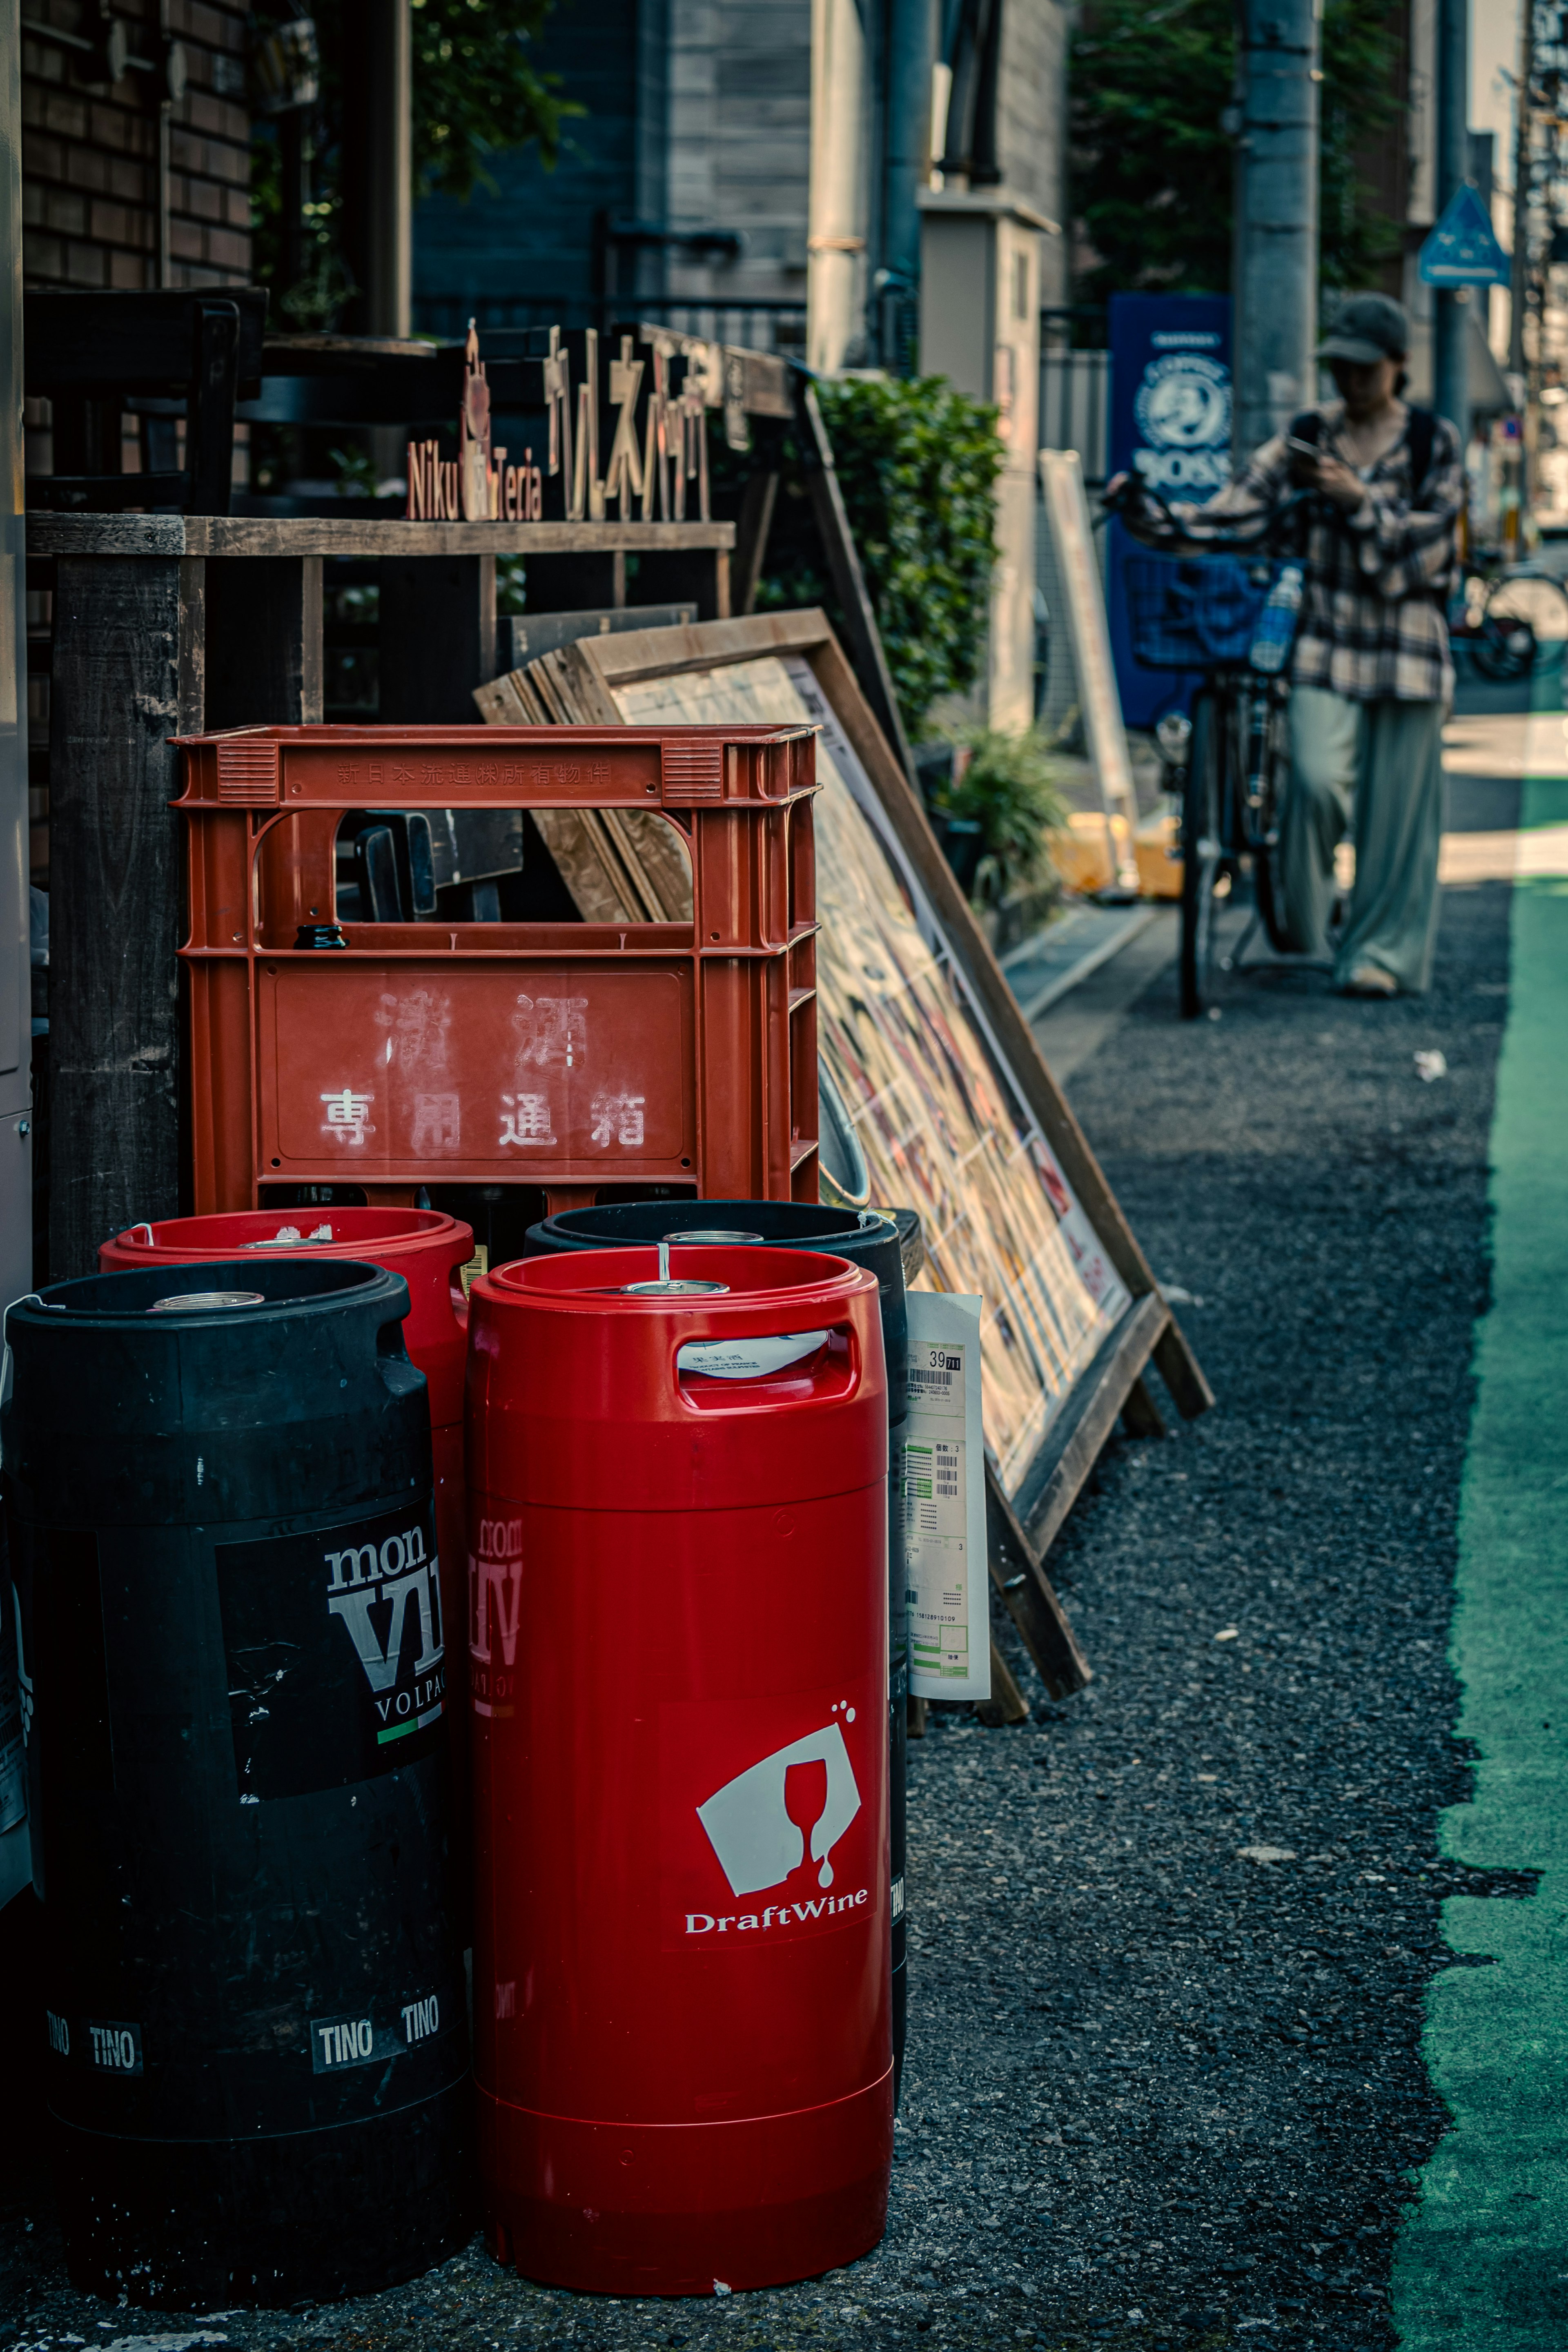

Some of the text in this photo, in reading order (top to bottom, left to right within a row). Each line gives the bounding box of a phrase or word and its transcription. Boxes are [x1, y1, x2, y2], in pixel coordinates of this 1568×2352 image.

[693, 1354, 743, 1363] 果実酒
[930, 1351, 945, 1368] 39
[947, 1359, 959, 1369] 711
[325, 1526, 426, 1591] mon
[917, 1613, 956, 1621] 158128910109
[685, 1889, 868, 1933] DraftWine
[47, 2009, 135, 2069] TINO TINO
[319, 1995, 439, 2064] TINO TINO
